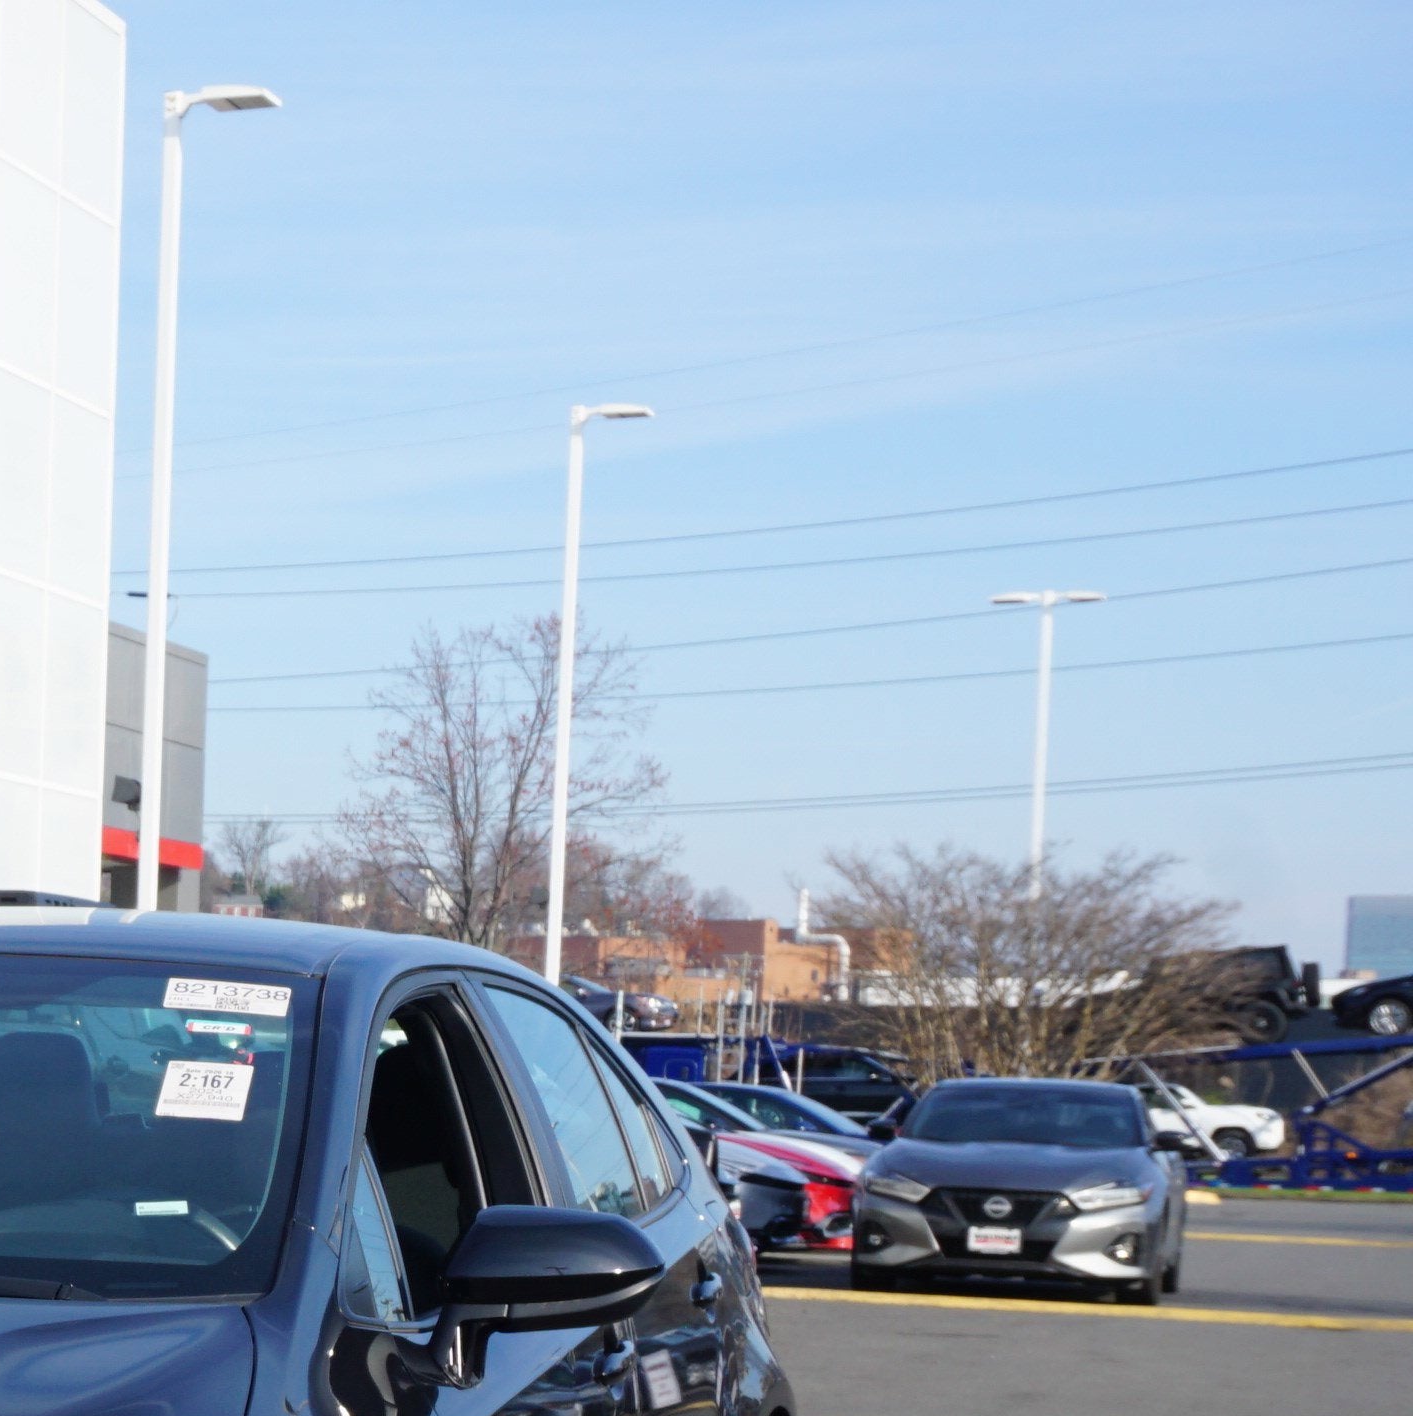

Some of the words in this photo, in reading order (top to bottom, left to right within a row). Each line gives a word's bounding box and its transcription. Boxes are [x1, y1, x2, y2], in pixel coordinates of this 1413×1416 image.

[174, 981, 289, 1001] 8213738
[202, 1024, 236, 1032] CR'D
[179, 1073, 234, 1089] 2:167
